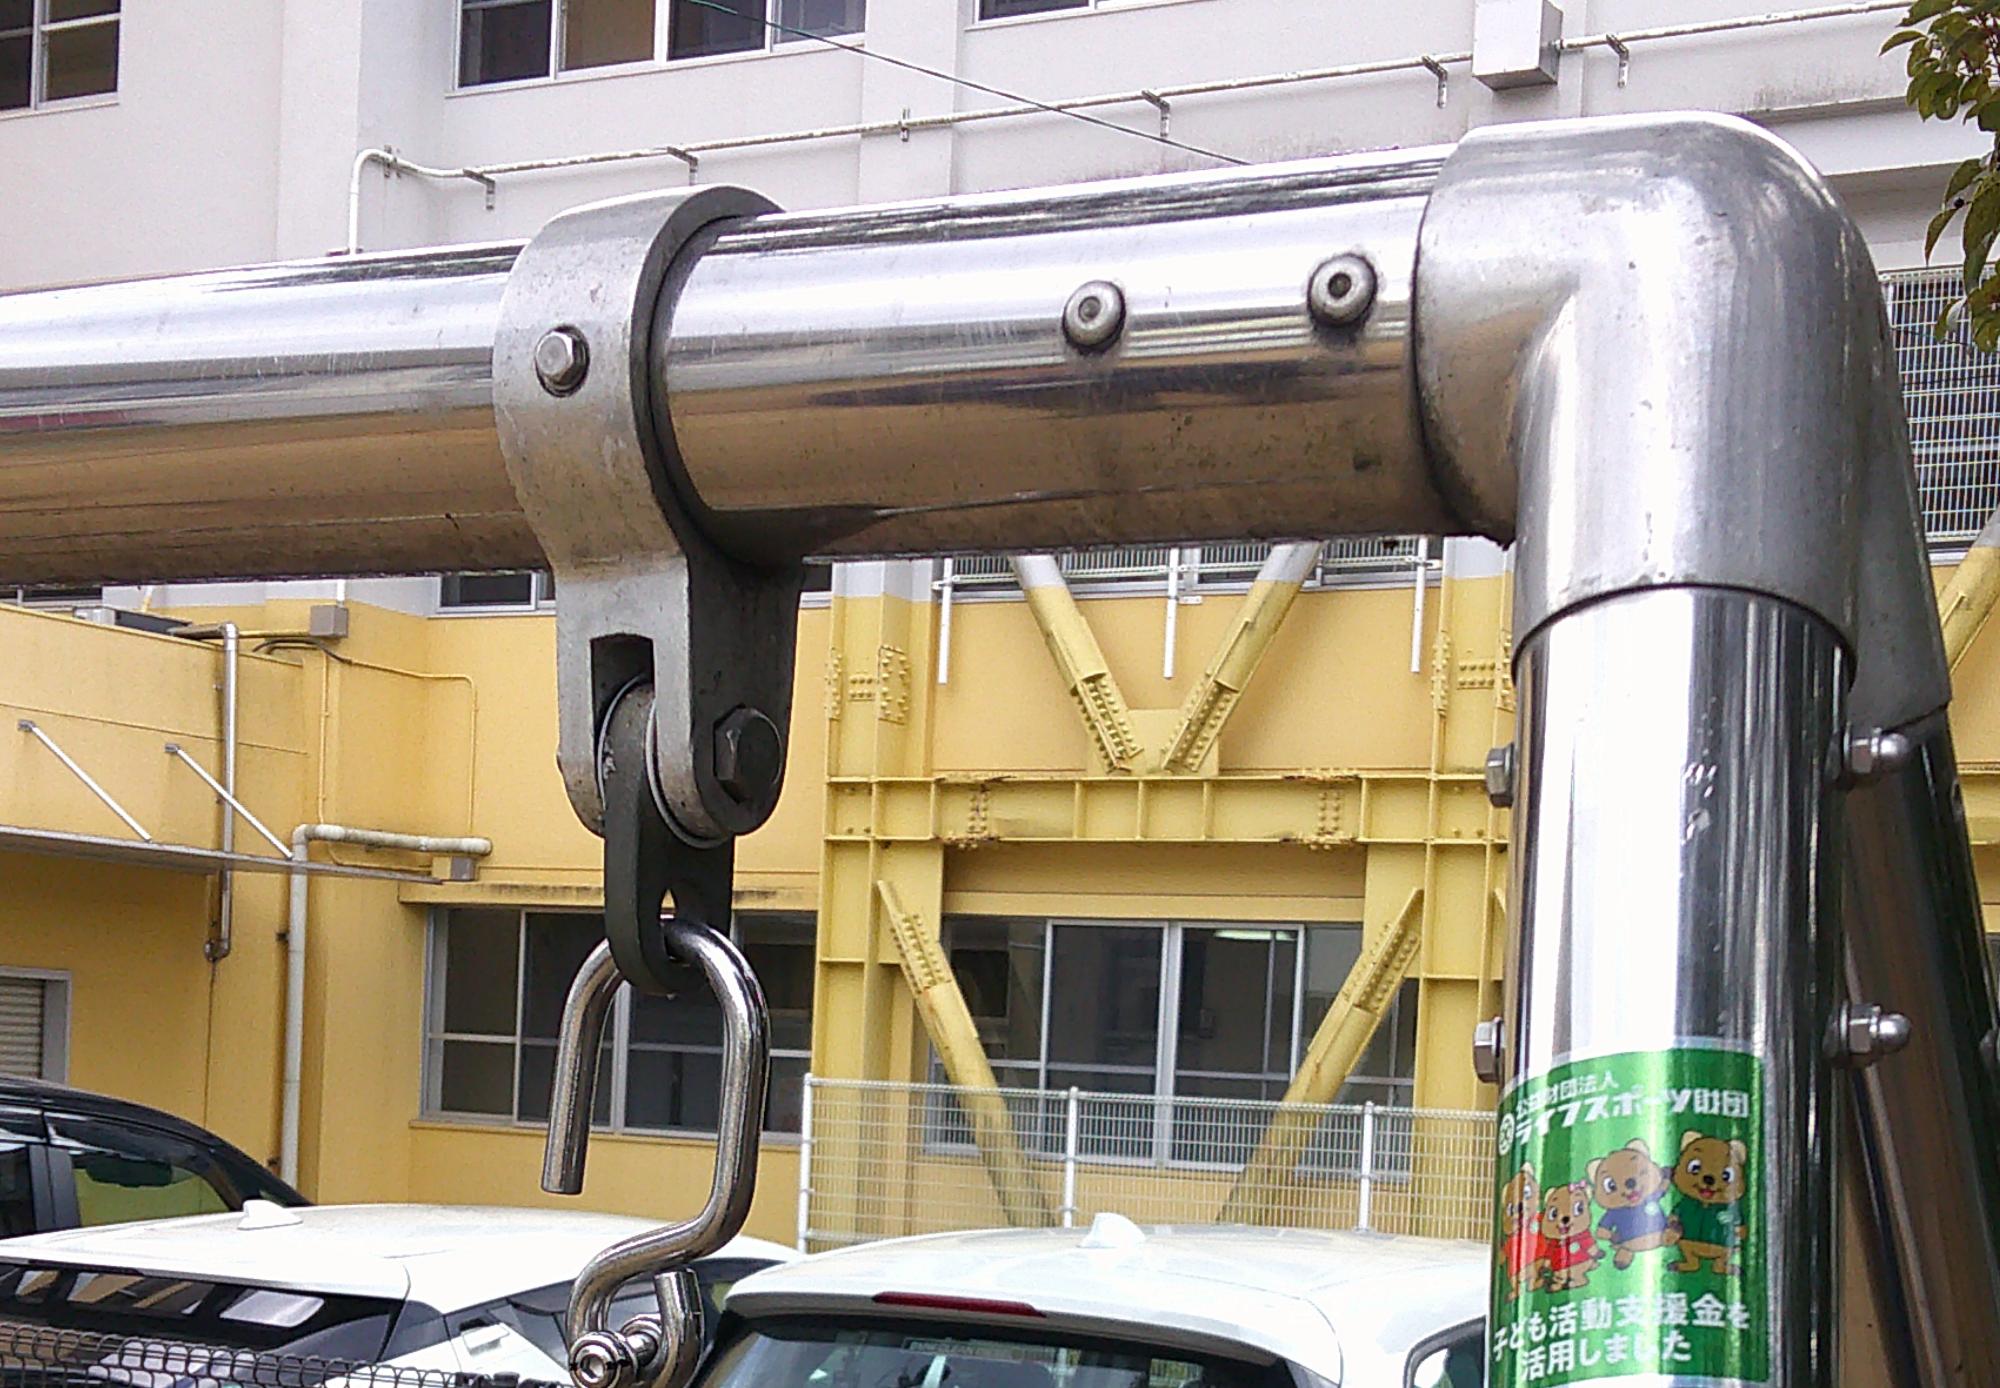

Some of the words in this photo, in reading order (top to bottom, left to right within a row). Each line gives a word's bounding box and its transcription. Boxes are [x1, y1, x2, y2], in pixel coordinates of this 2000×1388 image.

[1493, 1292, 1750, 1361] 子ども活動支援金を
[1522, 1329, 1692, 1381] 活用しました
